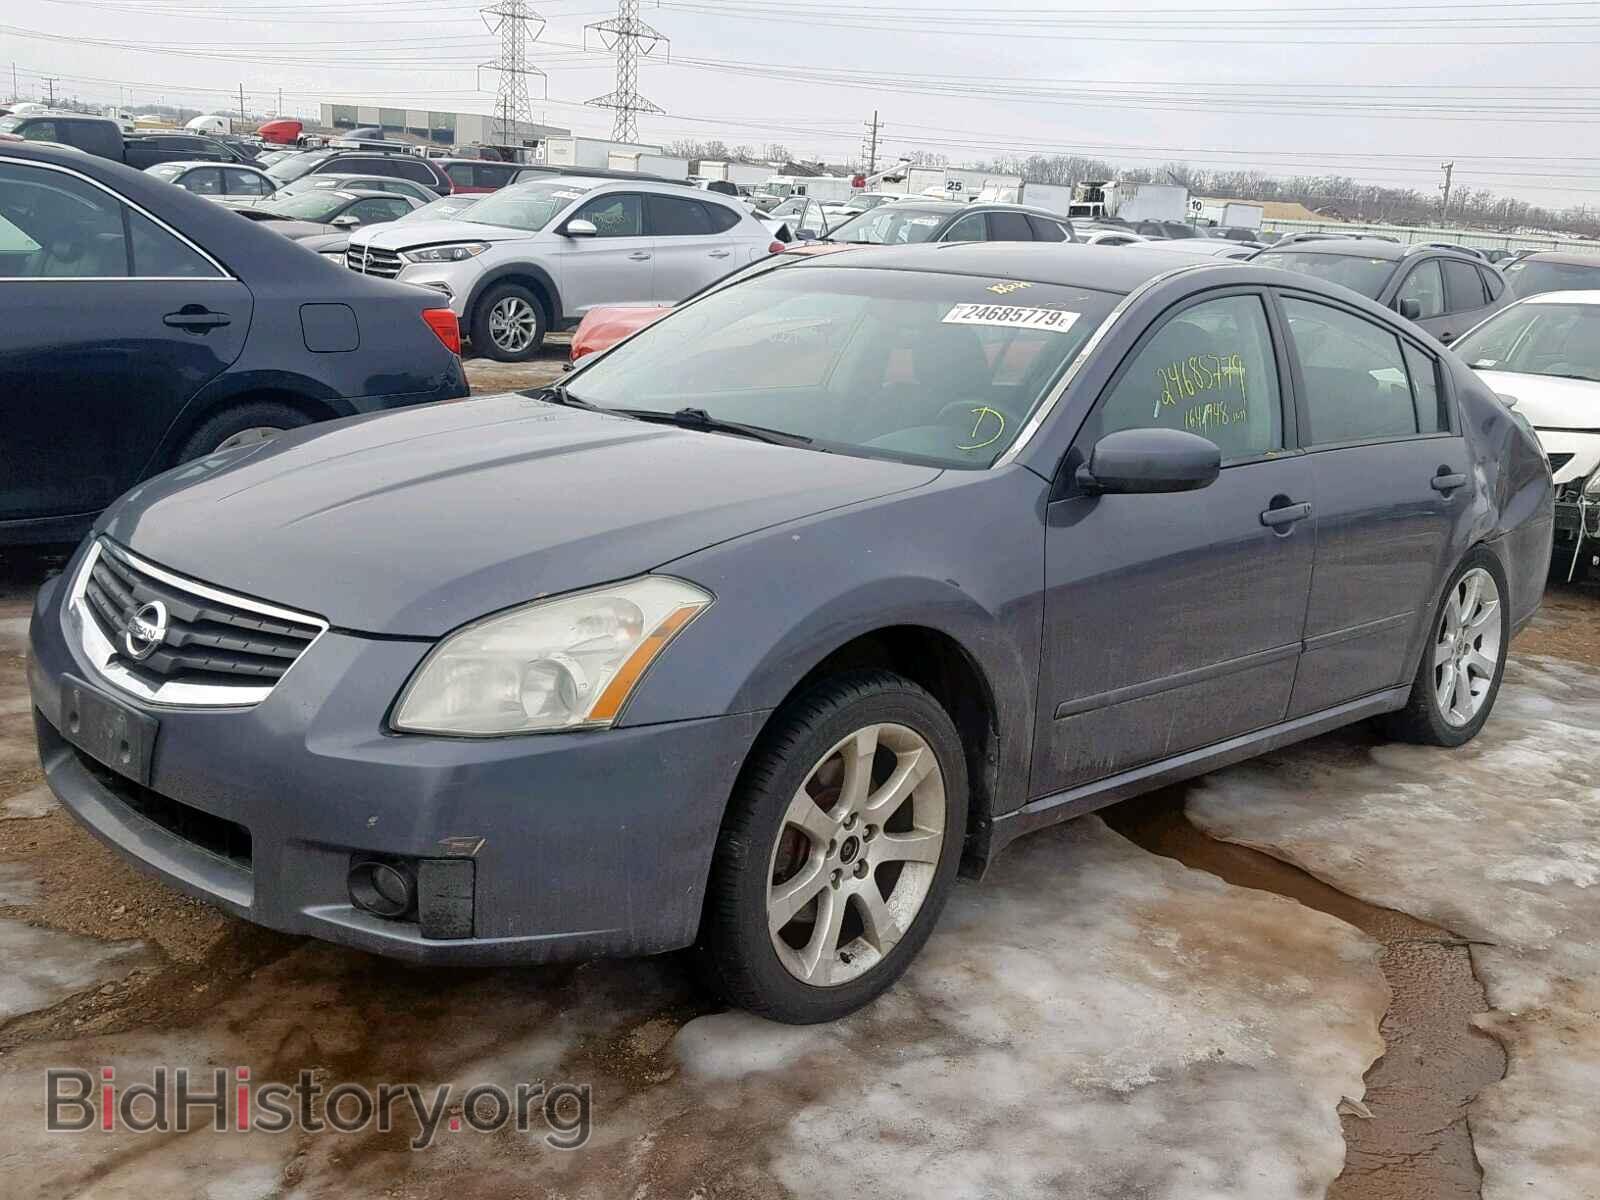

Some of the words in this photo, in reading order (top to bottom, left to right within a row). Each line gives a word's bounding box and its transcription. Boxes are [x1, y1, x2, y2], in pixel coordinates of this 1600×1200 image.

[946, 180, 962, 191] 25
[1191, 200, 1202, 211] 10
[962, 305, 1063, 326] 24685779
[956, 406, 1005, 450] D
